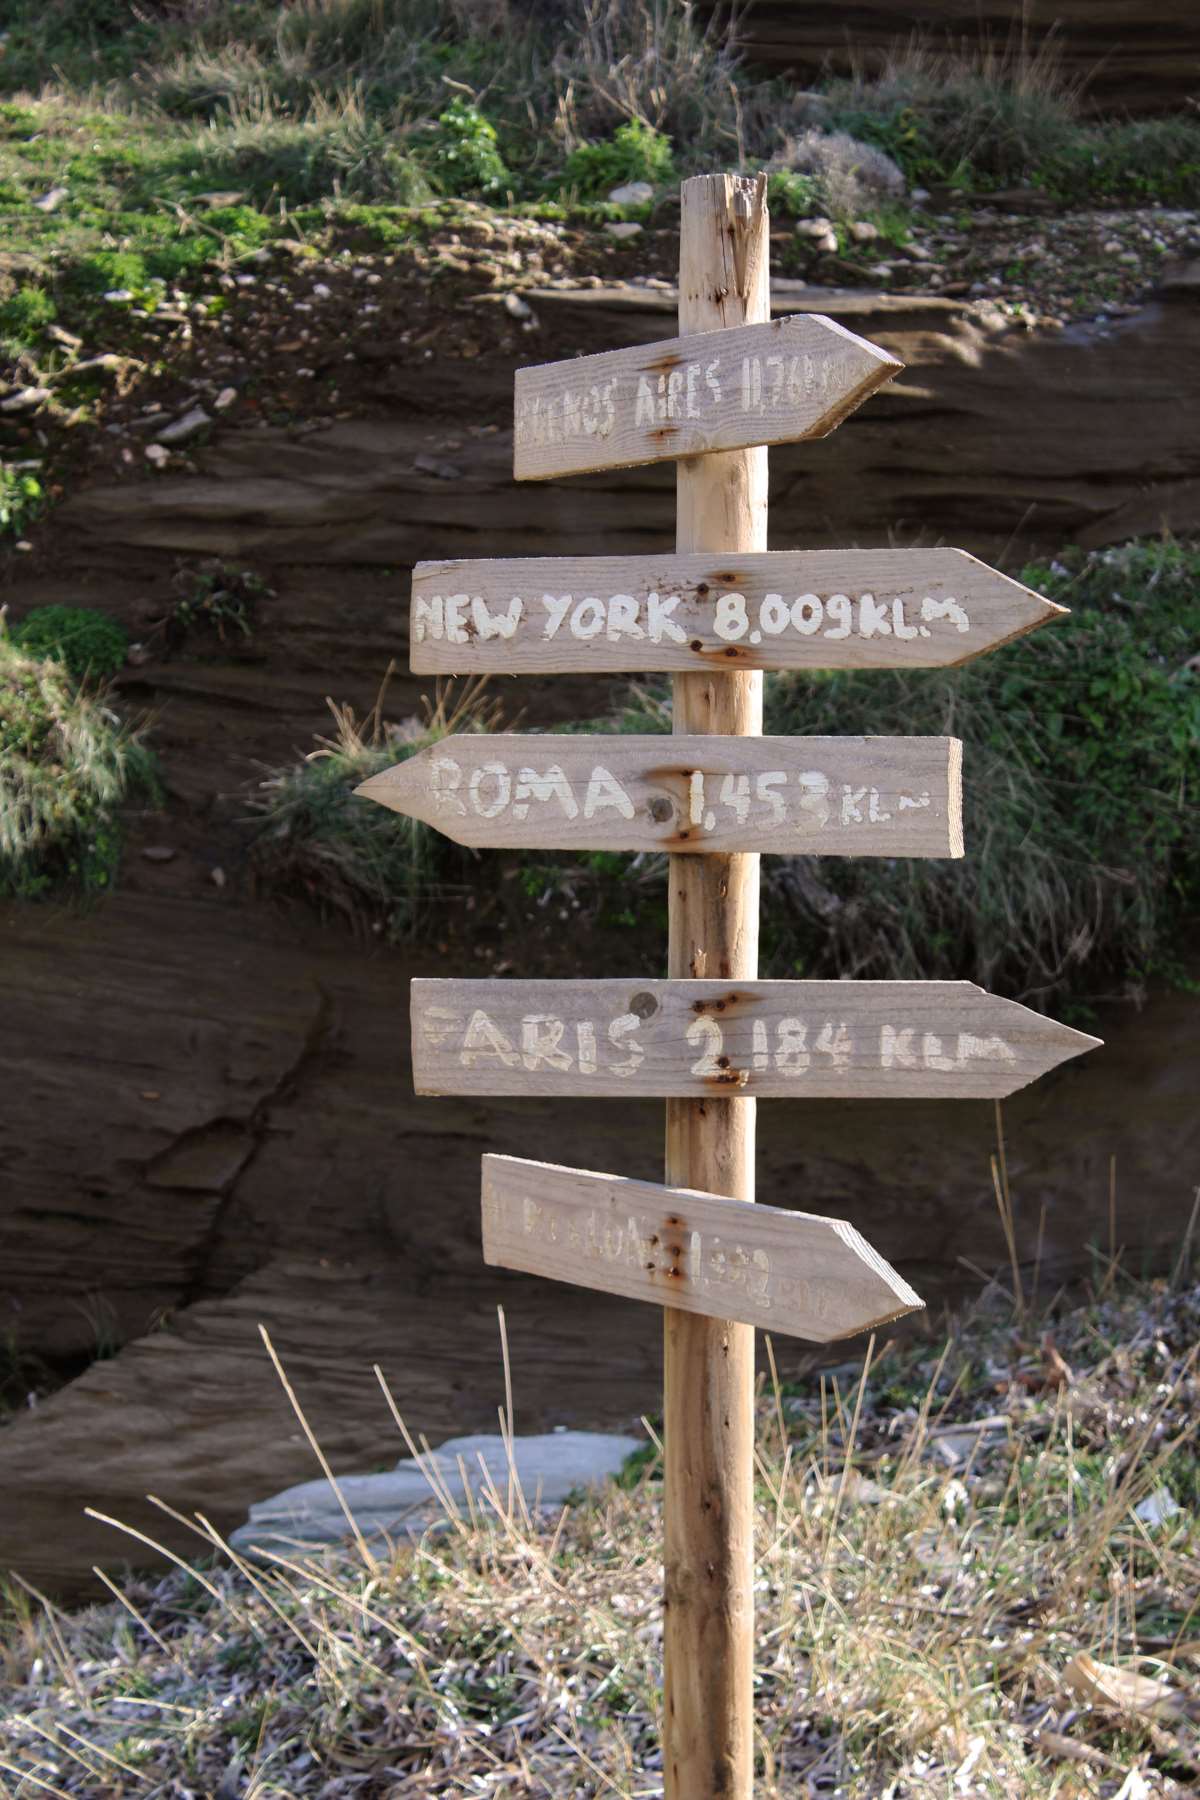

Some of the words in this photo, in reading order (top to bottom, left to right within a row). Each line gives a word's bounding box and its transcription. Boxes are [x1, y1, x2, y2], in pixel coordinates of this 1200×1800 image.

[635, 358, 722, 427] AIRES
[415, 594, 523, 644] NEW
[542, 592, 688, 644] YORK
[430, 757, 635, 820] ROMA
